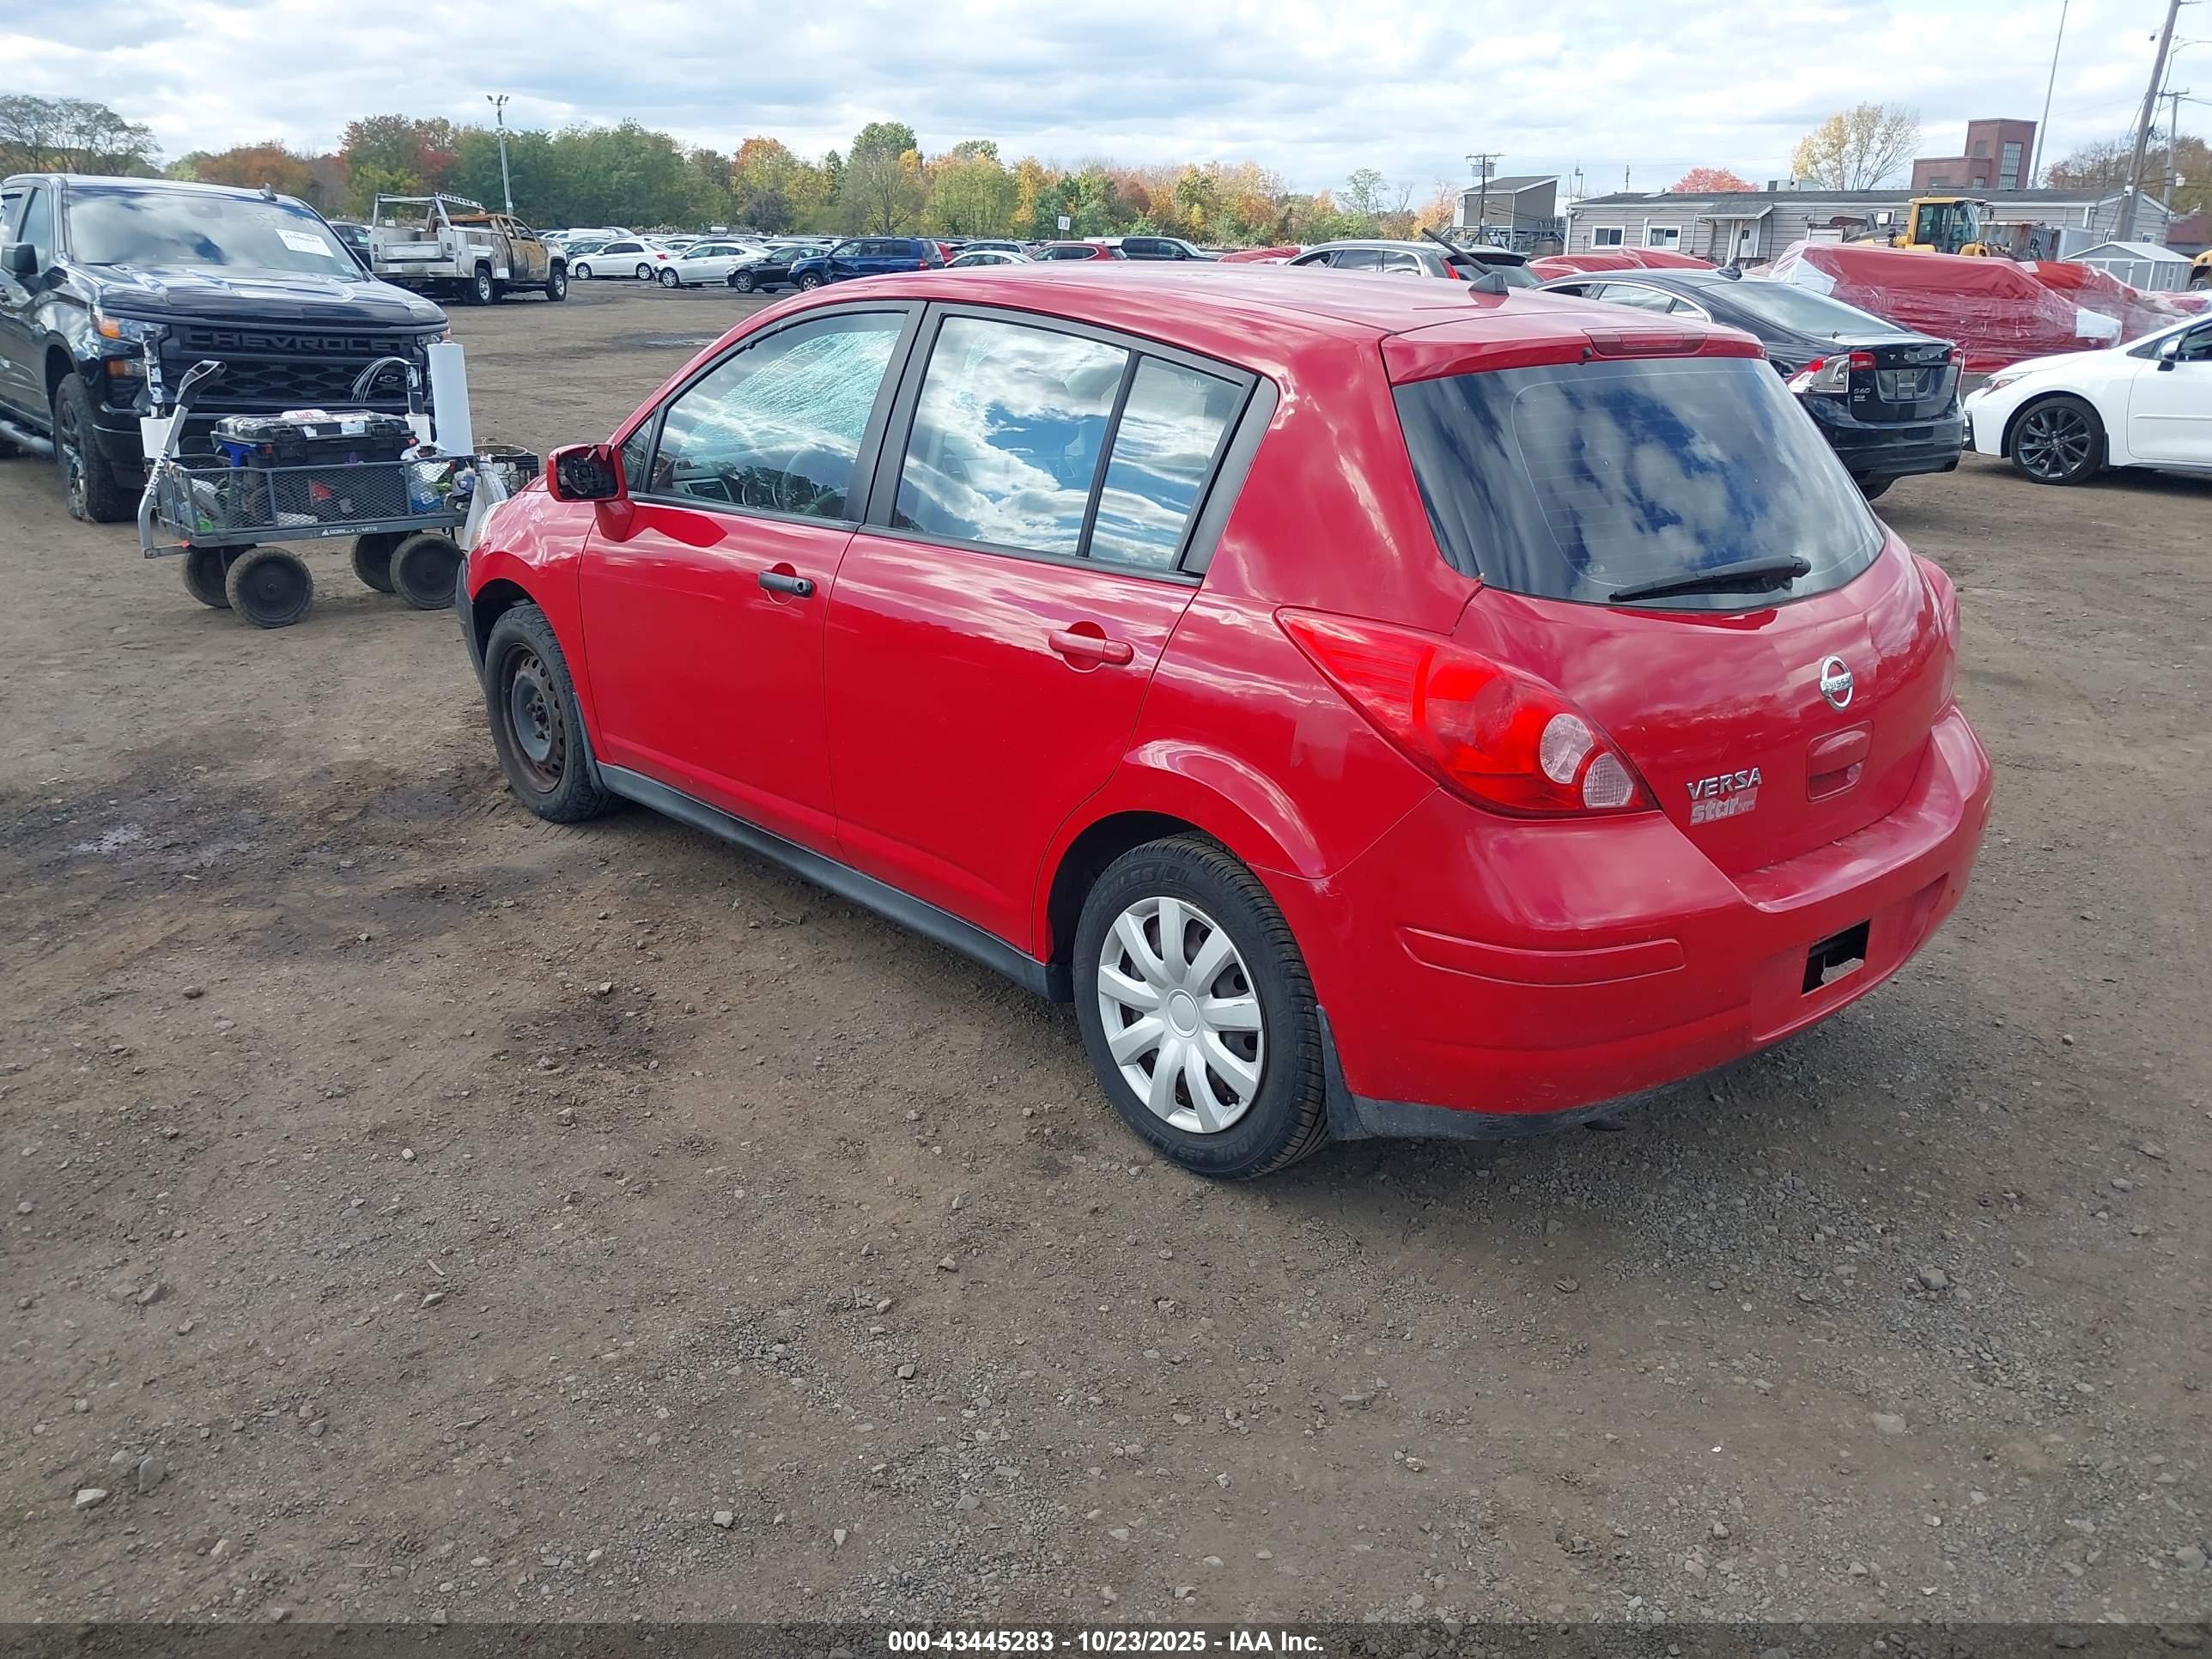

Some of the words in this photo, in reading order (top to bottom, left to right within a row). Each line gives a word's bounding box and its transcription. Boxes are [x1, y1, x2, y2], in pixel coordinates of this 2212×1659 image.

[185, 331, 414, 351] CHEVROLET
[1824, 676, 1850, 690] NISSA
[1686, 767, 1763, 800] VERSA
[1692, 795, 1740, 823] star
